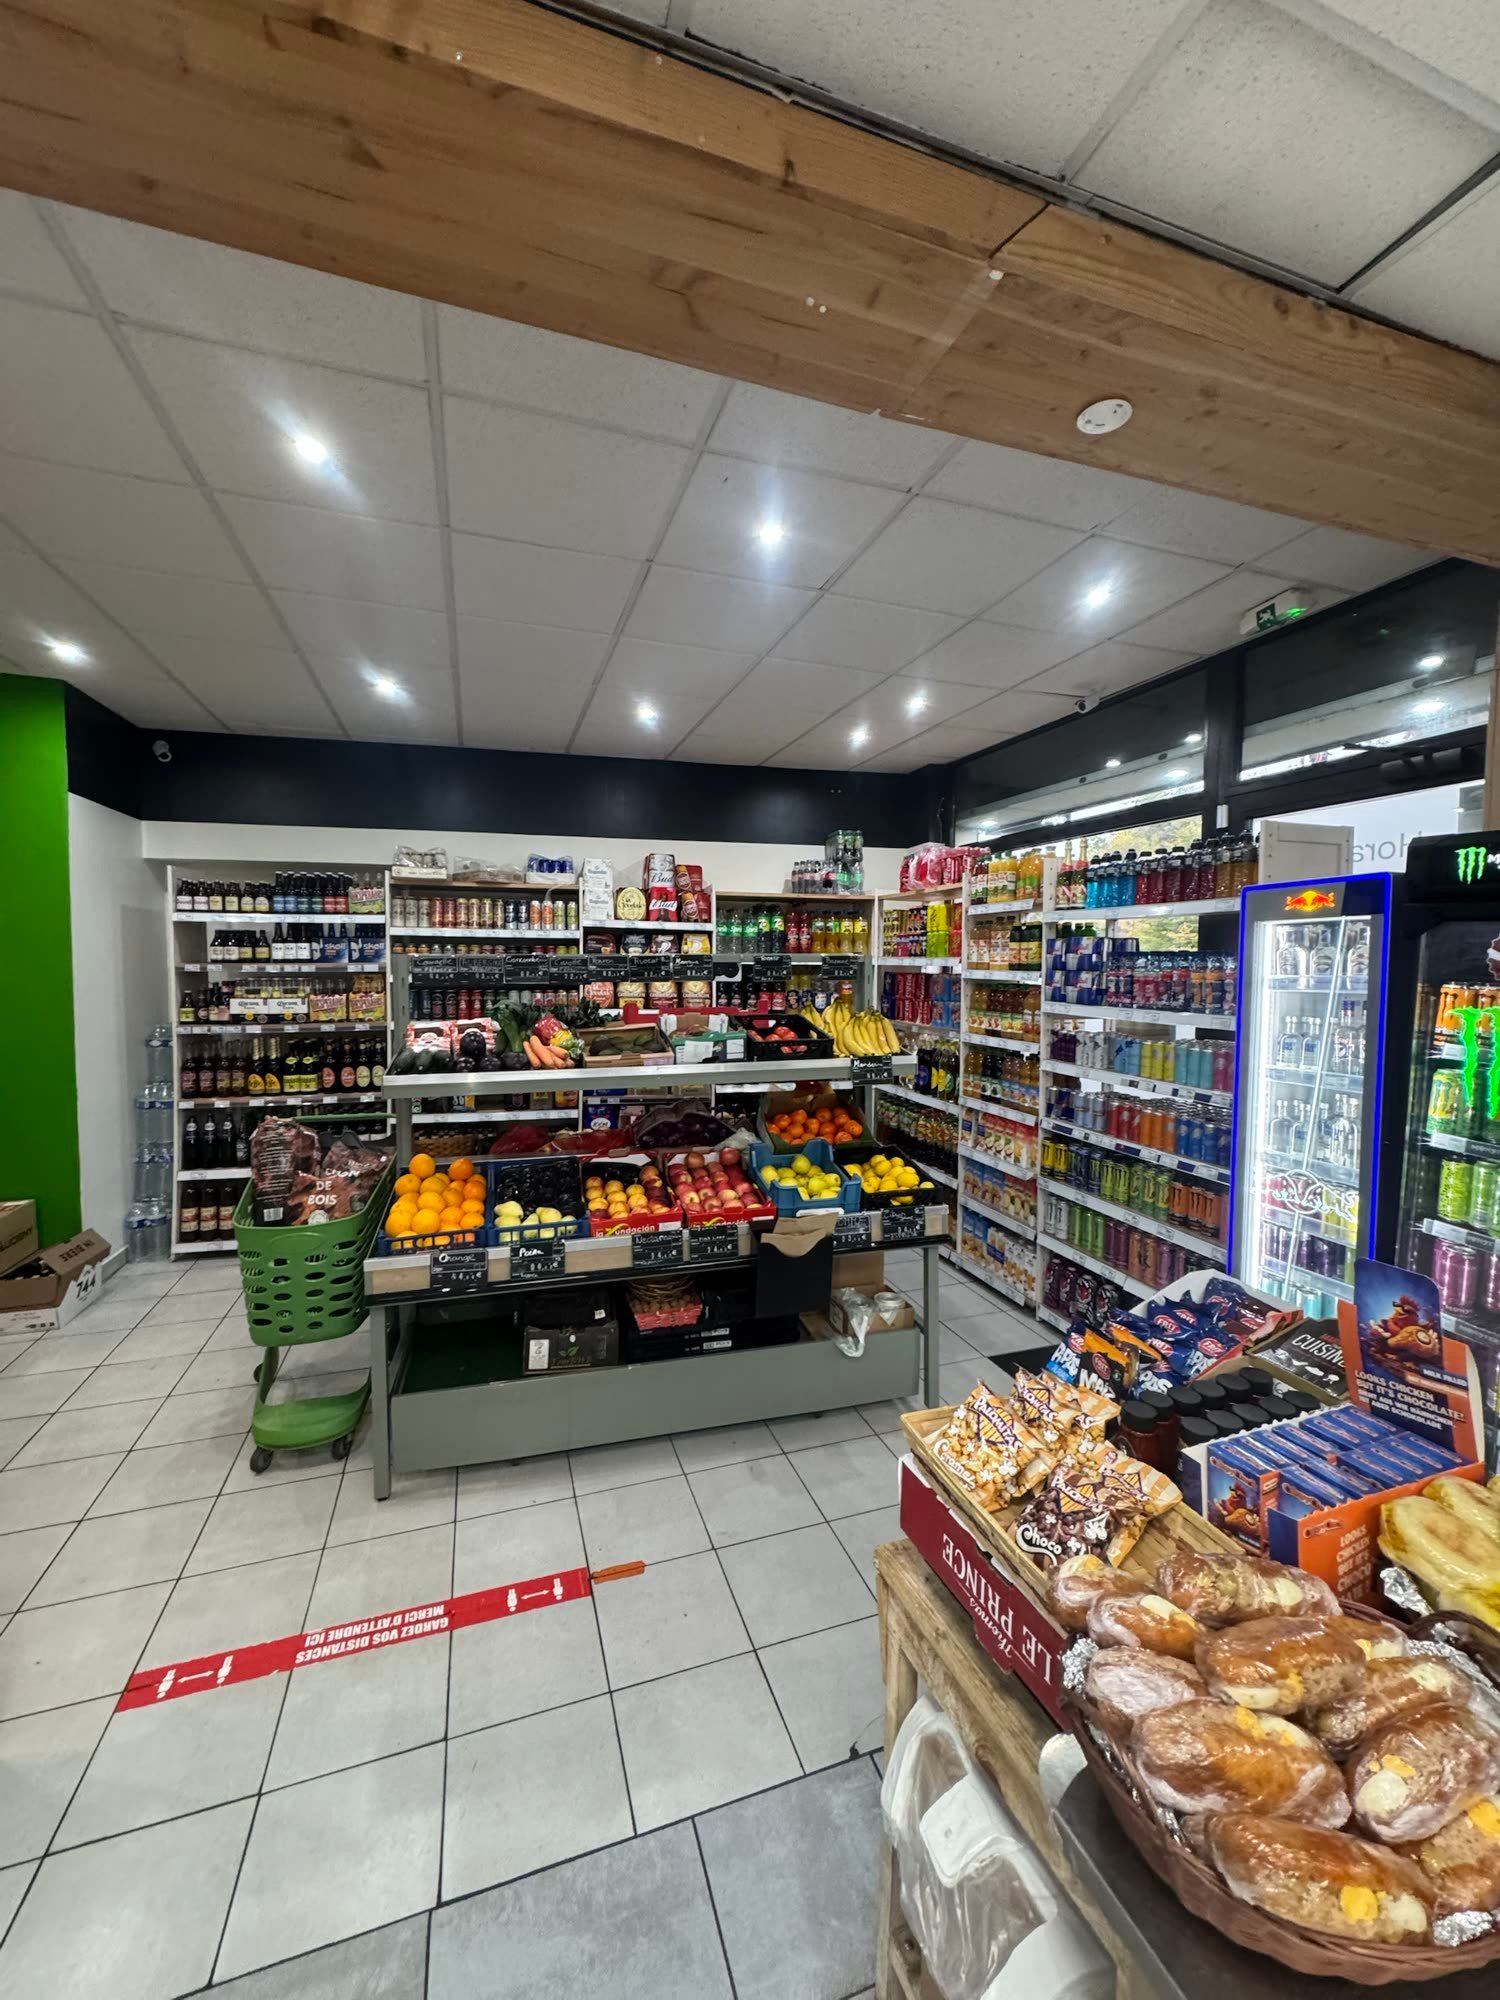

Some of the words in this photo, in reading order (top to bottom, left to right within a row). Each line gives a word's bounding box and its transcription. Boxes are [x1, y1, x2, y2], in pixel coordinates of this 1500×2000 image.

[316, 1181, 332, 1190] DE
[307, 1195, 337, 1206] BOIS
[1355, 1370, 1386, 1387] LOOKS
[1389, 1380, 1434, 1402] CHICKEN
[1397, 1390, 1465, 1420] CHOCOLATE!
[974, 1395, 1023, 1452] PALOMITAS
[1016, 1524, 1062, 1565] Choco
[943, 1533, 1015, 1640] PRINCE
[327, 1614, 401, 1642] D'ATTENDRE
[401, 1617, 450, 1637] GARDEZ
[404, 1605, 445, 1623] MERCI
[295, 1636, 370, 1664] DISTANCES
[304, 1635, 325, 1647] ICI
[372, 1629, 398, 1645] VOS
[1022, 1625, 1053, 1685] LE
